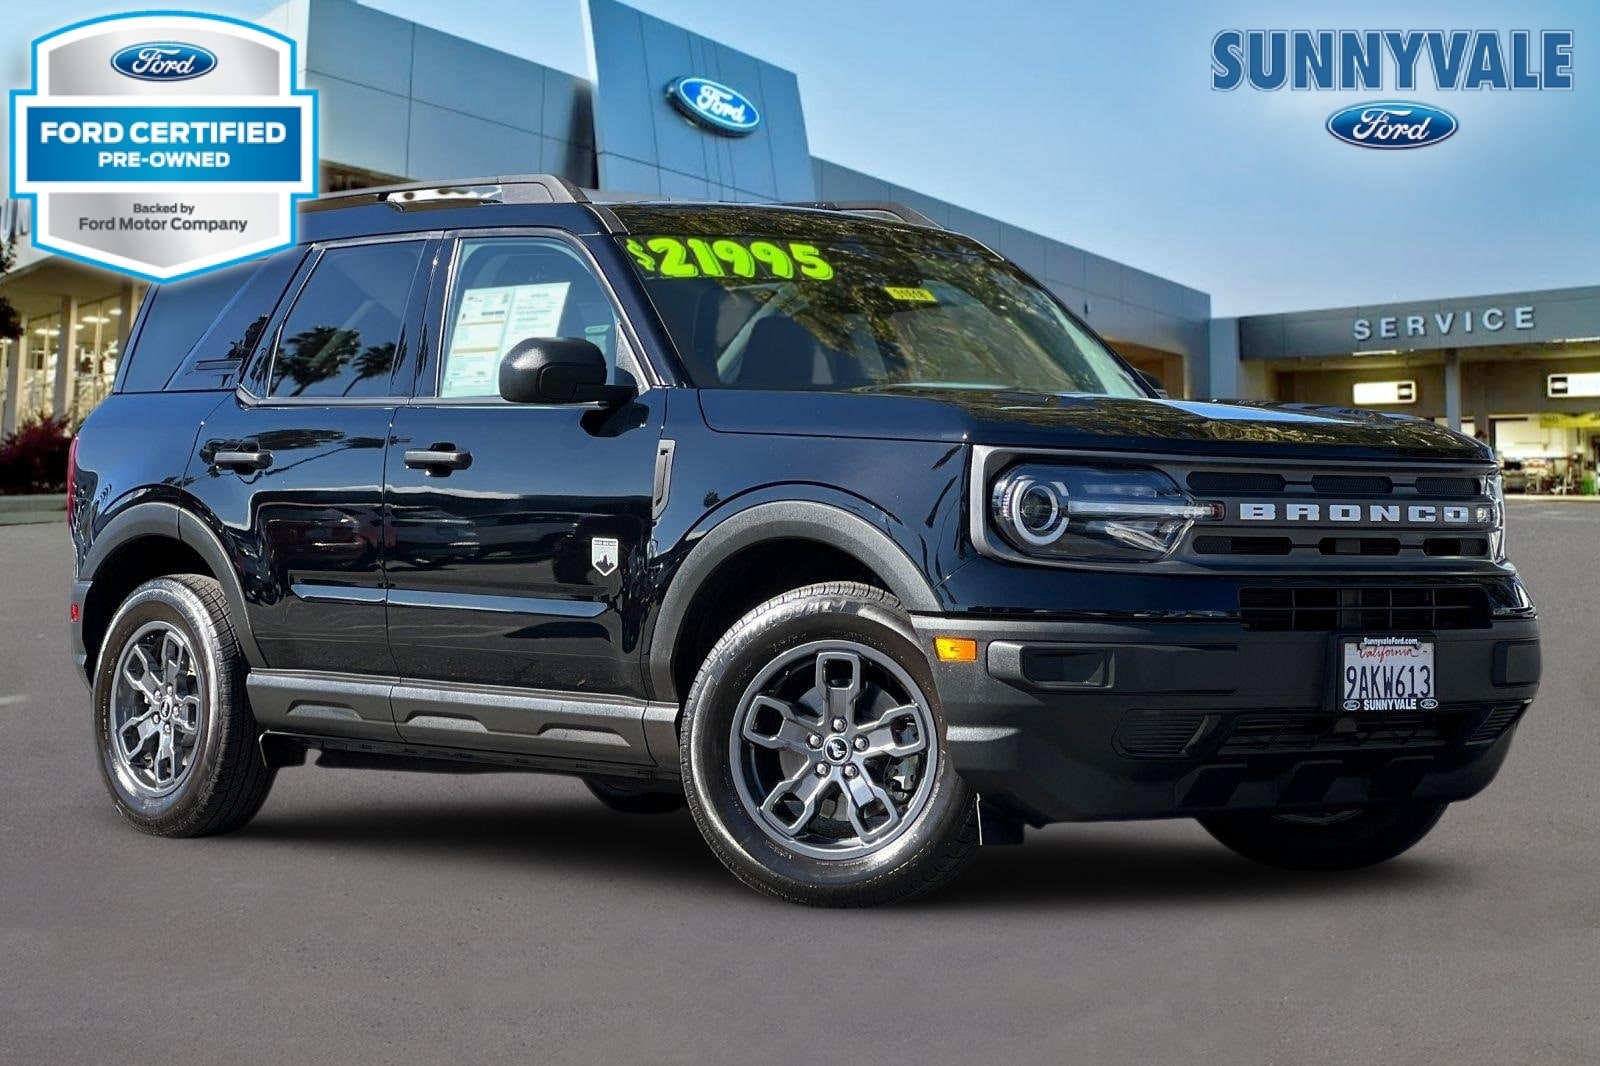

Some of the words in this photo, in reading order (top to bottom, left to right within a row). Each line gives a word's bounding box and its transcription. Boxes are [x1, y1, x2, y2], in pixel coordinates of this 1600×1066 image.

[696, 85, 747, 123] Ford
[626, 237, 834, 281] $21995
[1353, 306, 1535, 341] SERVICE
[1240, 503, 1469, 523] BRONCO
[1363, 637, 1417, 646] SunnyvaleFord.com
[1346, 665, 1431, 699] 9AKW613
[1363, 699, 1417, 711] SUNNYVALE
